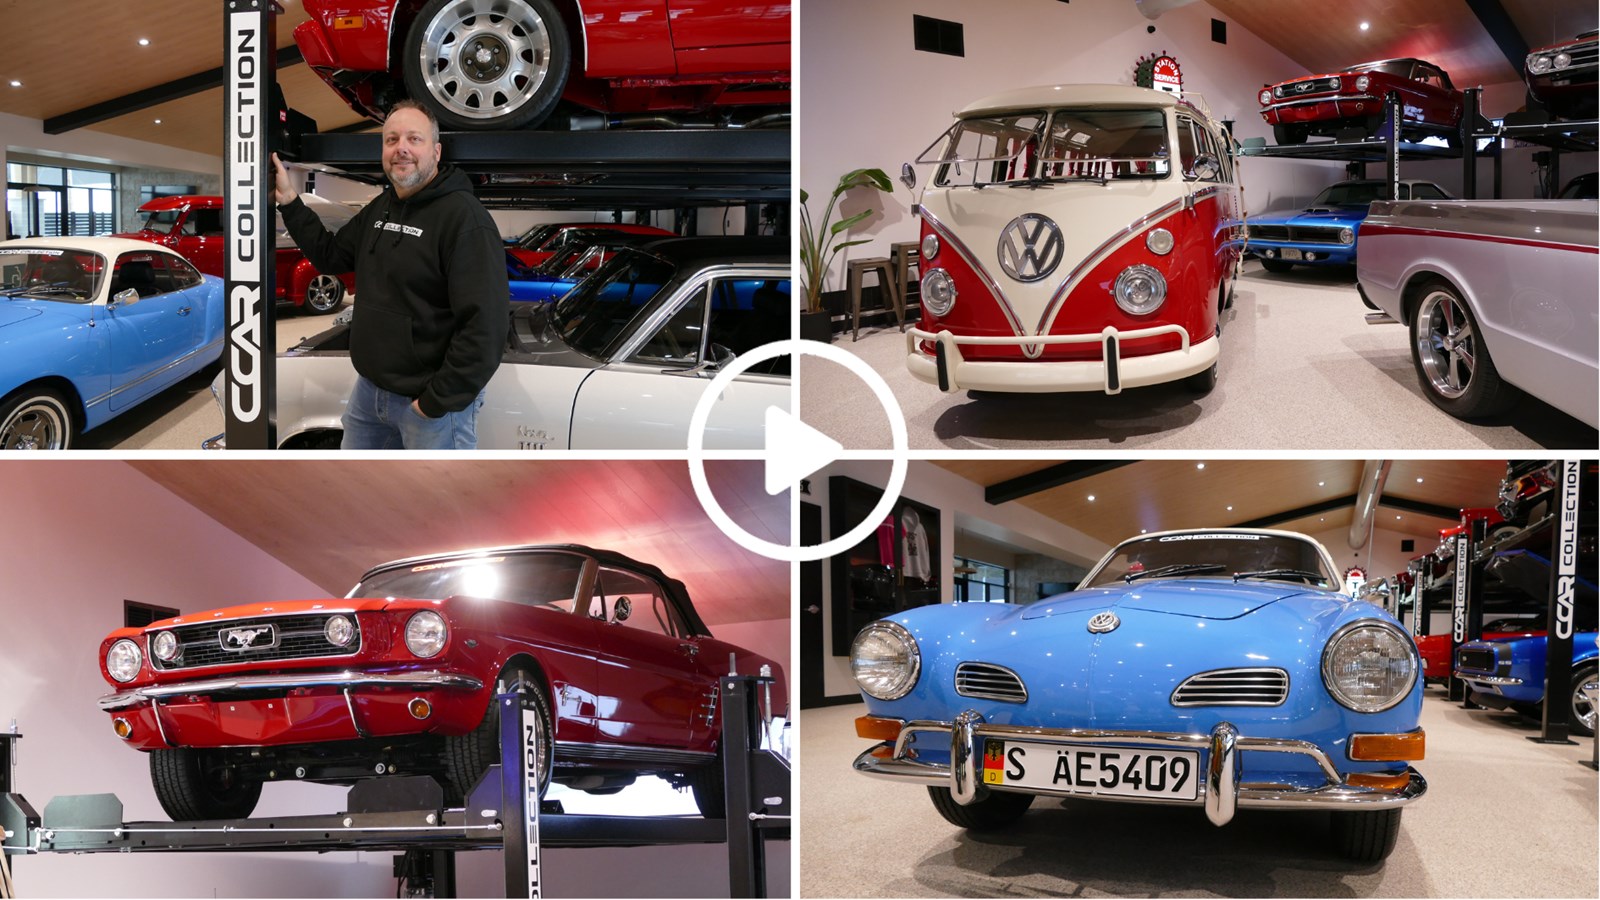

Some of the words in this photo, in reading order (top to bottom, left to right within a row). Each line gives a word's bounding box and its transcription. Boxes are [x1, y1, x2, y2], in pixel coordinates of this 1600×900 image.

[1154, 59, 1179, 76] STATION
[1154, 73, 1179, 83] SERVICE
[237, 29, 255, 263] COLLECTION
[1563, 461, 1578, 566] COLLECTION
[1457, 542, 1467, 602] COLLECTION
[1005, 746, 1026, 781] S
[1052, 750, 1191, 793] ÄE5409
